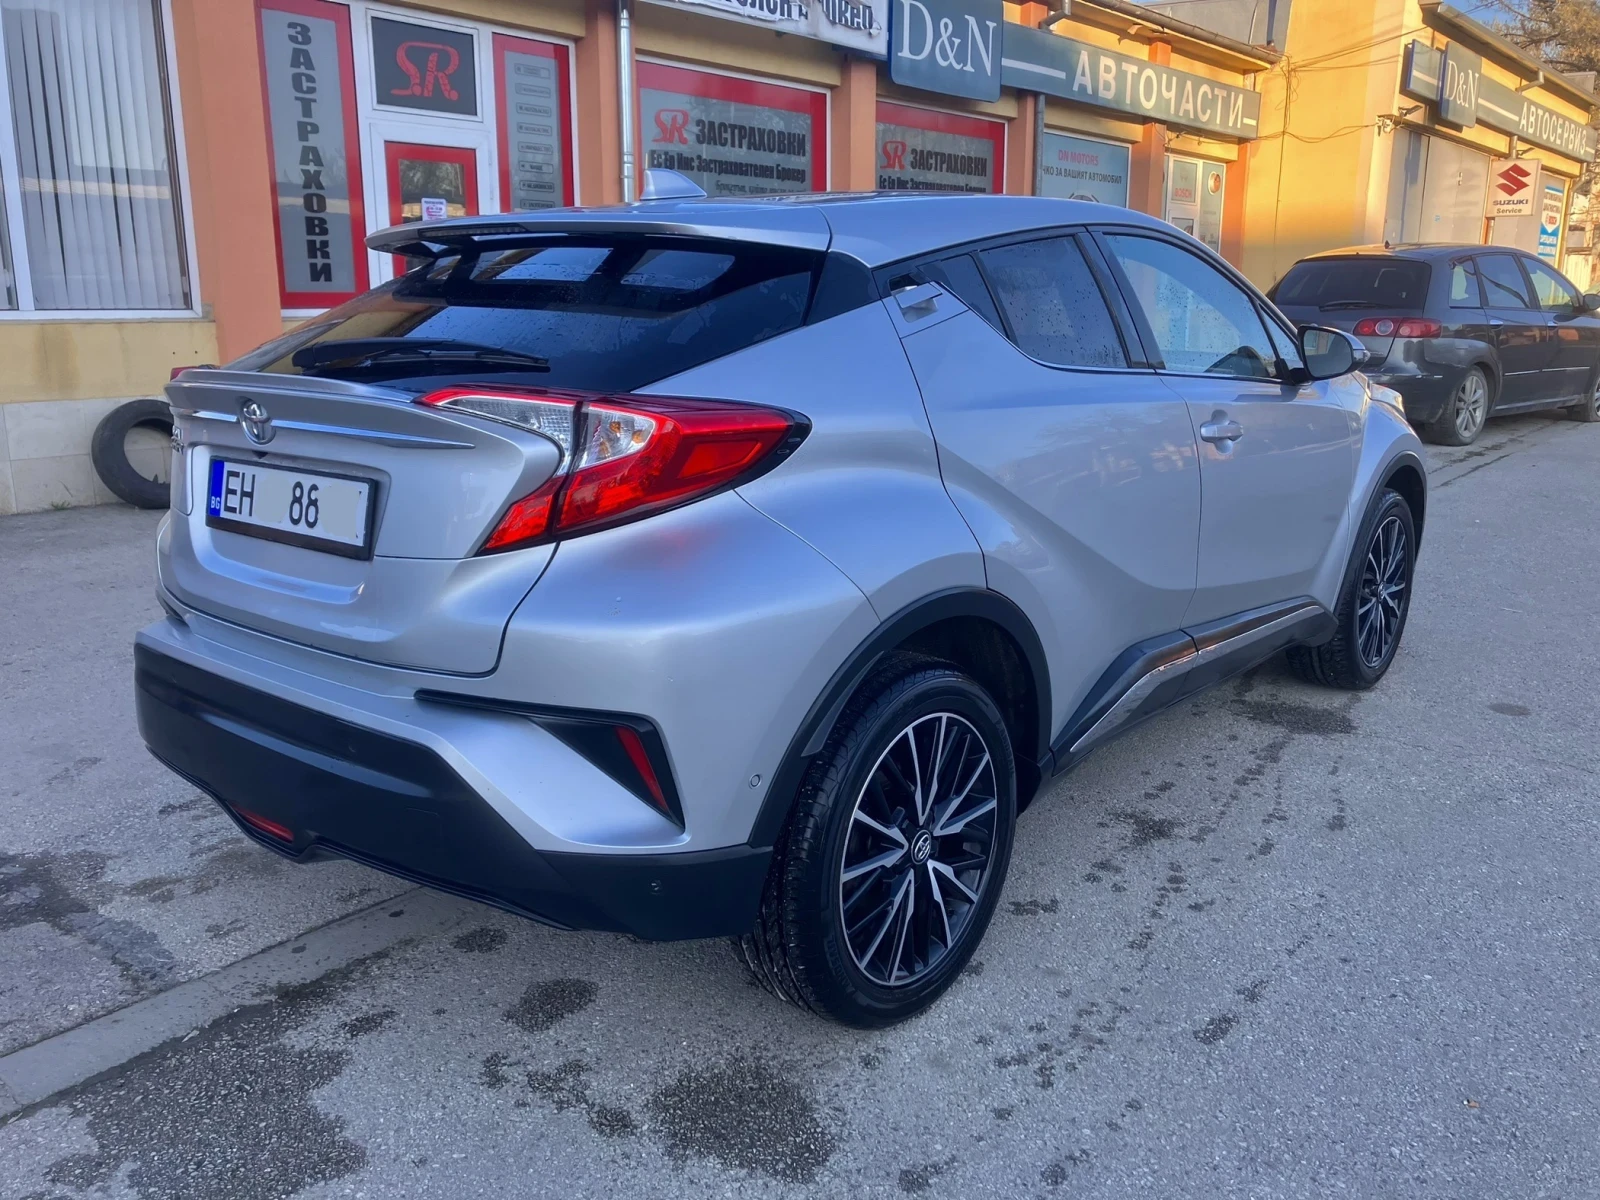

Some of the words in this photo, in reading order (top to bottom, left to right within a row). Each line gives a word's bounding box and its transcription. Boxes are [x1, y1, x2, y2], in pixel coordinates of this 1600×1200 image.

[897, 0, 997, 77] D&N
[1072, 50, 1245, 129] АВТОЧАСТИ
[1446, 59, 1479, 111] D&N
[695, 118, 807, 158] ЗАСТРАХОВКИ
[1519, 101, 1587, 155] АВТОСЕРВИЗ
[287, 21, 333, 283] ЗАСТРАХОВКИ
[696, 154, 775, 180] Застрахователен
[776, 164, 807, 184] Брокер
[910, 147, 988, 178] ЗАСТРАХОВКИ
[1058, 149, 1069, 162] DN
[1070, 152, 1099, 167] MOTORS
[1055, 167, 1063, 177] ЗА
[1064, 168, 1088, 181] ВАШИЯТ
[1088, 171, 1122, 185] АВТОМОБИЛ
[1493, 198, 1529, 206] SUZUKI
[210, 495, 221, 509] BG
[223, 469, 256, 517] EH
